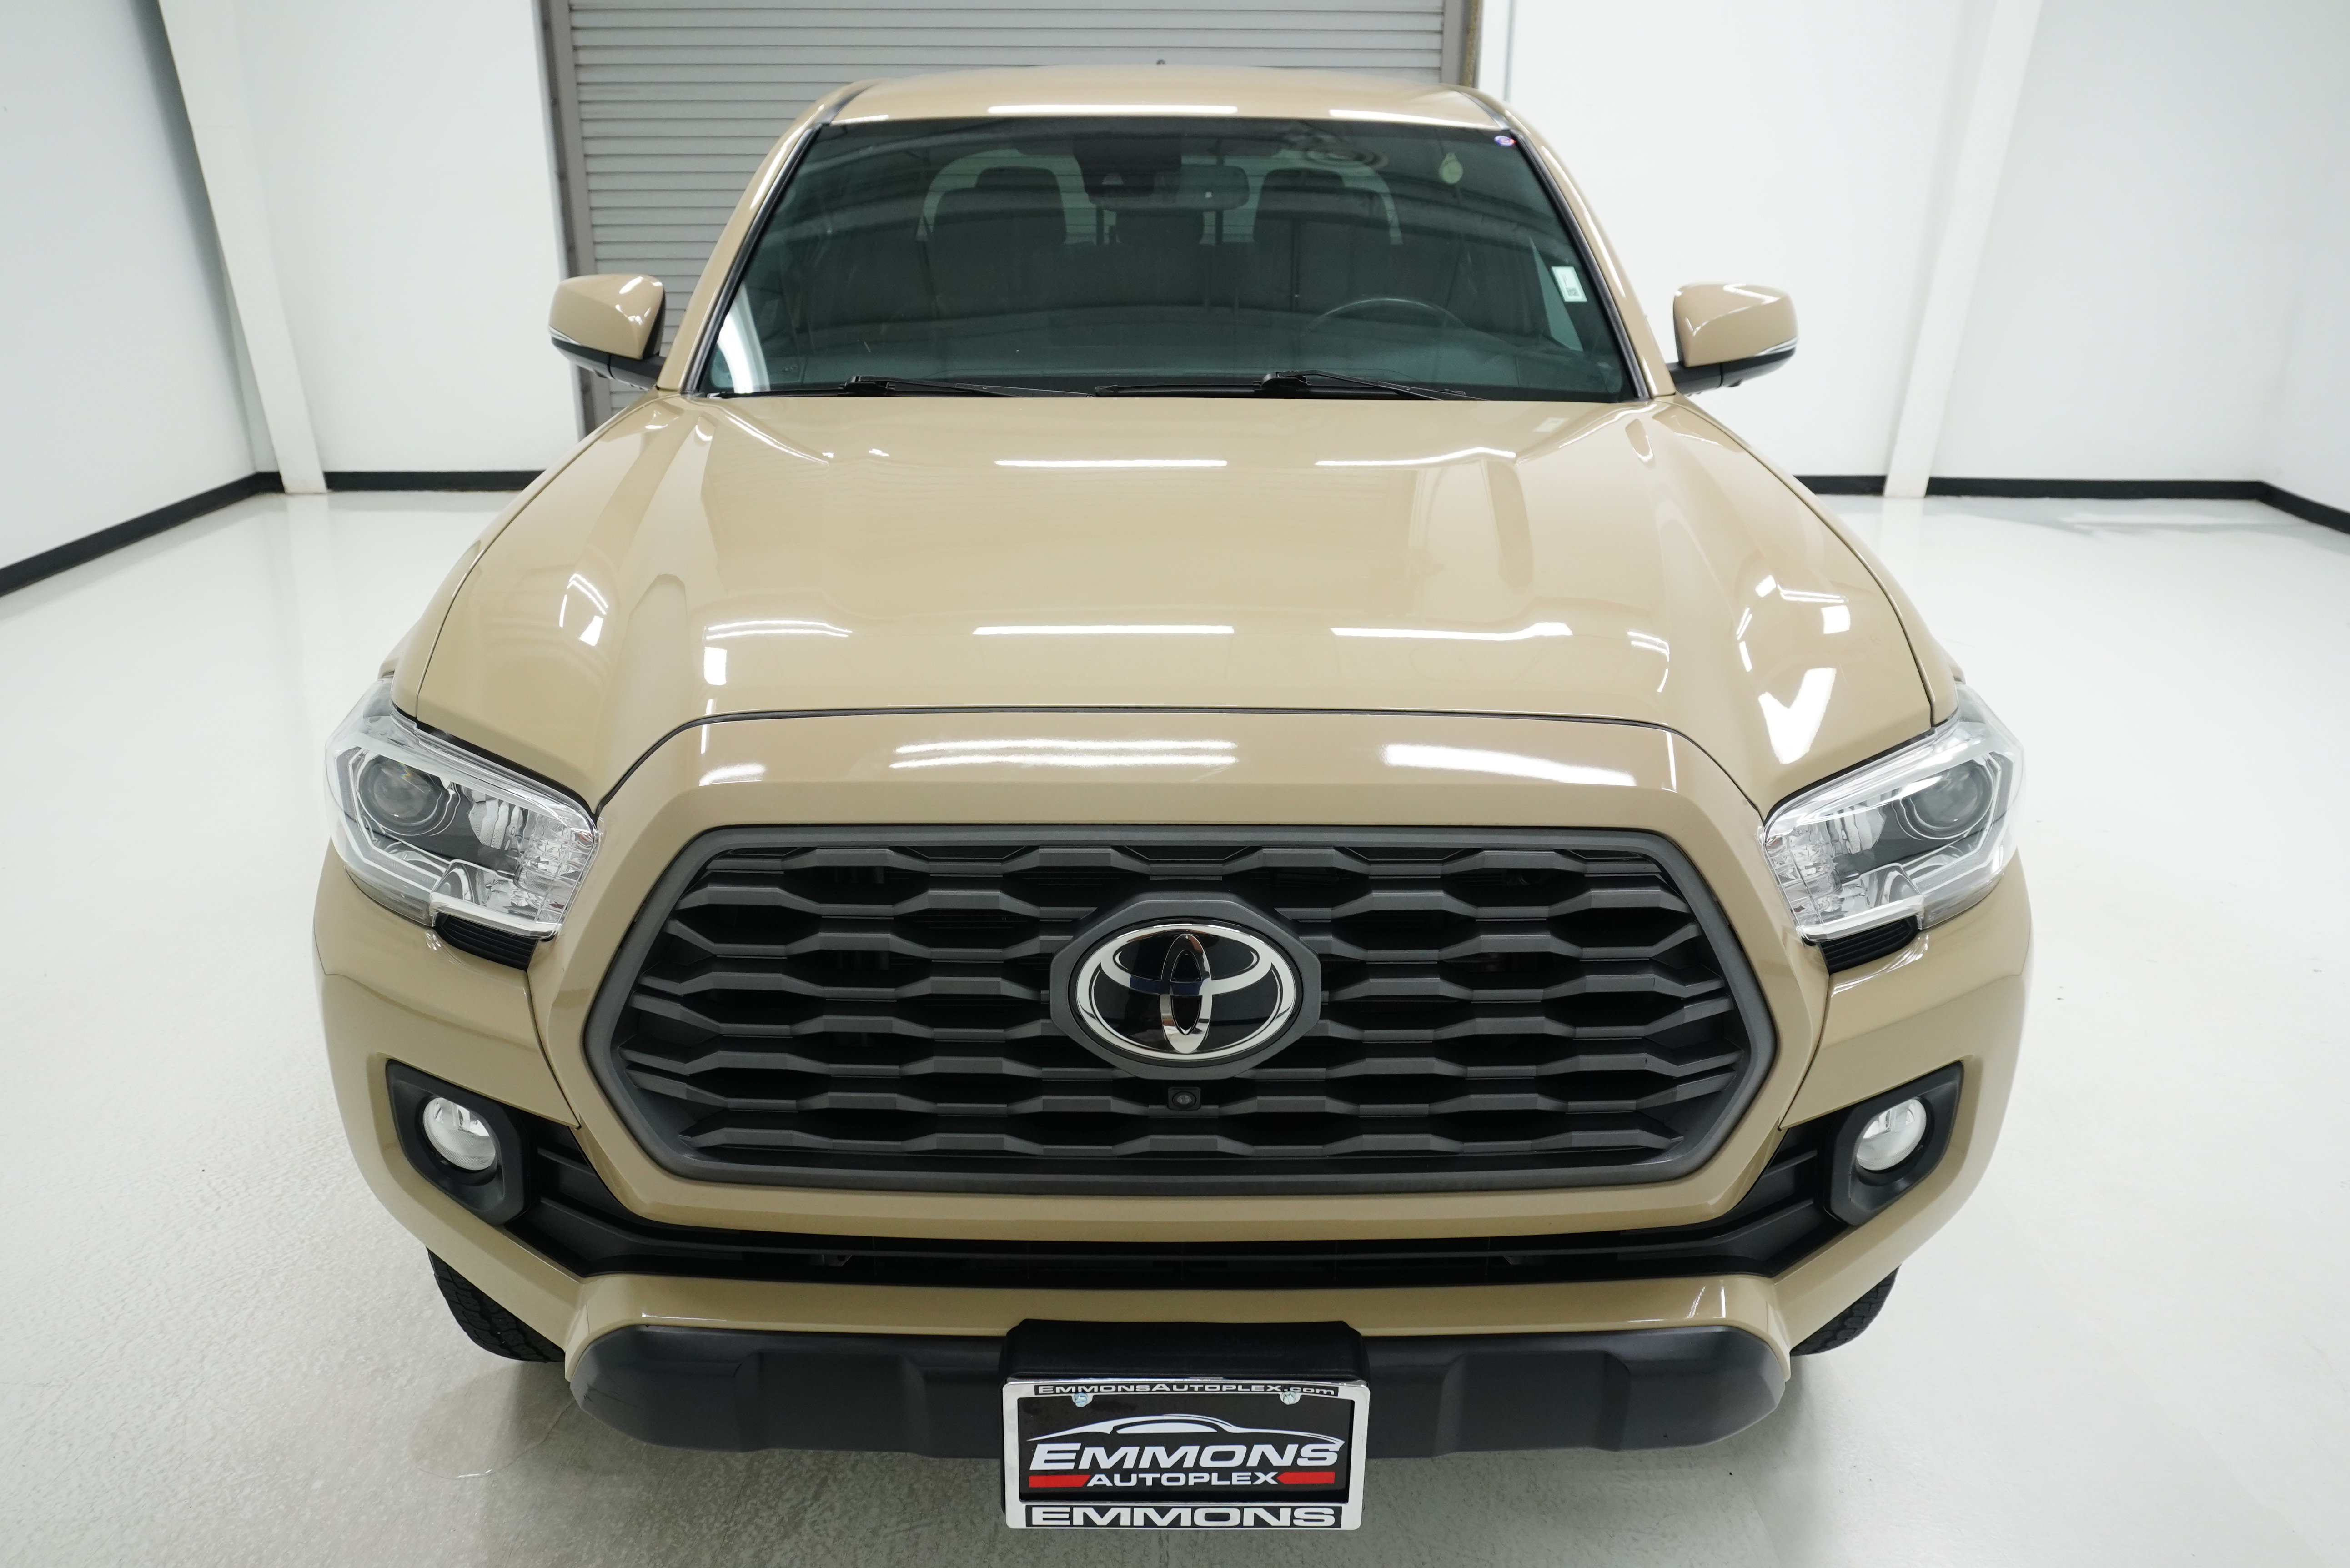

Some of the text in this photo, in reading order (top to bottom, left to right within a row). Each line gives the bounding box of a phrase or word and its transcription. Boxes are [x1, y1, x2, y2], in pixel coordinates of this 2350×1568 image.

[1038, 1383, 1335, 1395] EMMONSAUTOPLEX.com
[1029, 1443, 1338, 1470] EMMONS
[1086, 1472, 1278, 1487] AUTOPLEX
[1032, 1507, 1335, 1527] EMMONS
